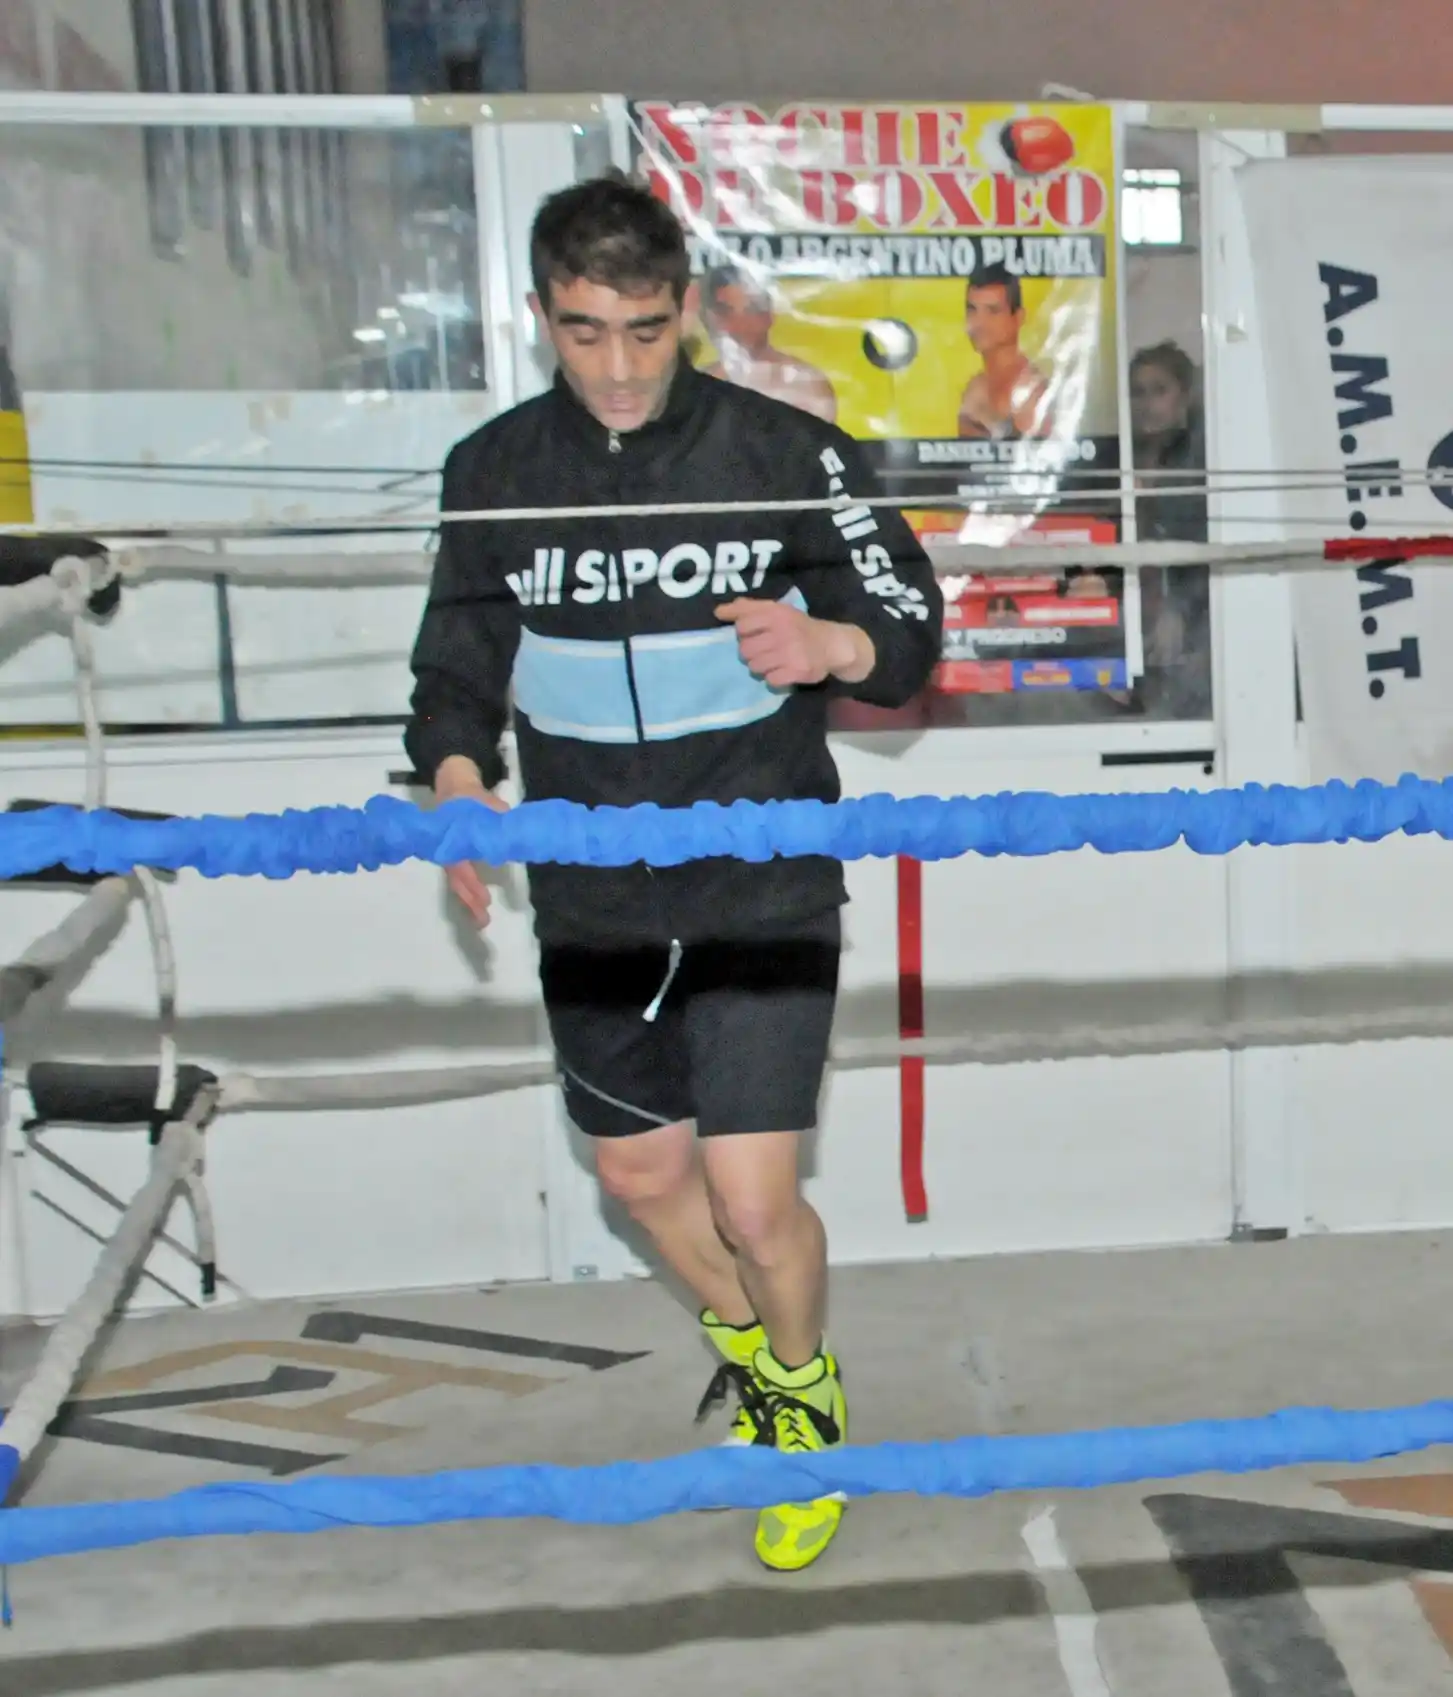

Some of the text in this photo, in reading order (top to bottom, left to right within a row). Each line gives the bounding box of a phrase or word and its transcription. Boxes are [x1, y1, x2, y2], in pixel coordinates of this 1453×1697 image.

[637, 101, 968, 171] NOCHE
[795, 168, 1107, 232] BOXEO
[776, 234, 977, 278] ARGENTINO
[980, 234, 1097, 276] PLUMA
